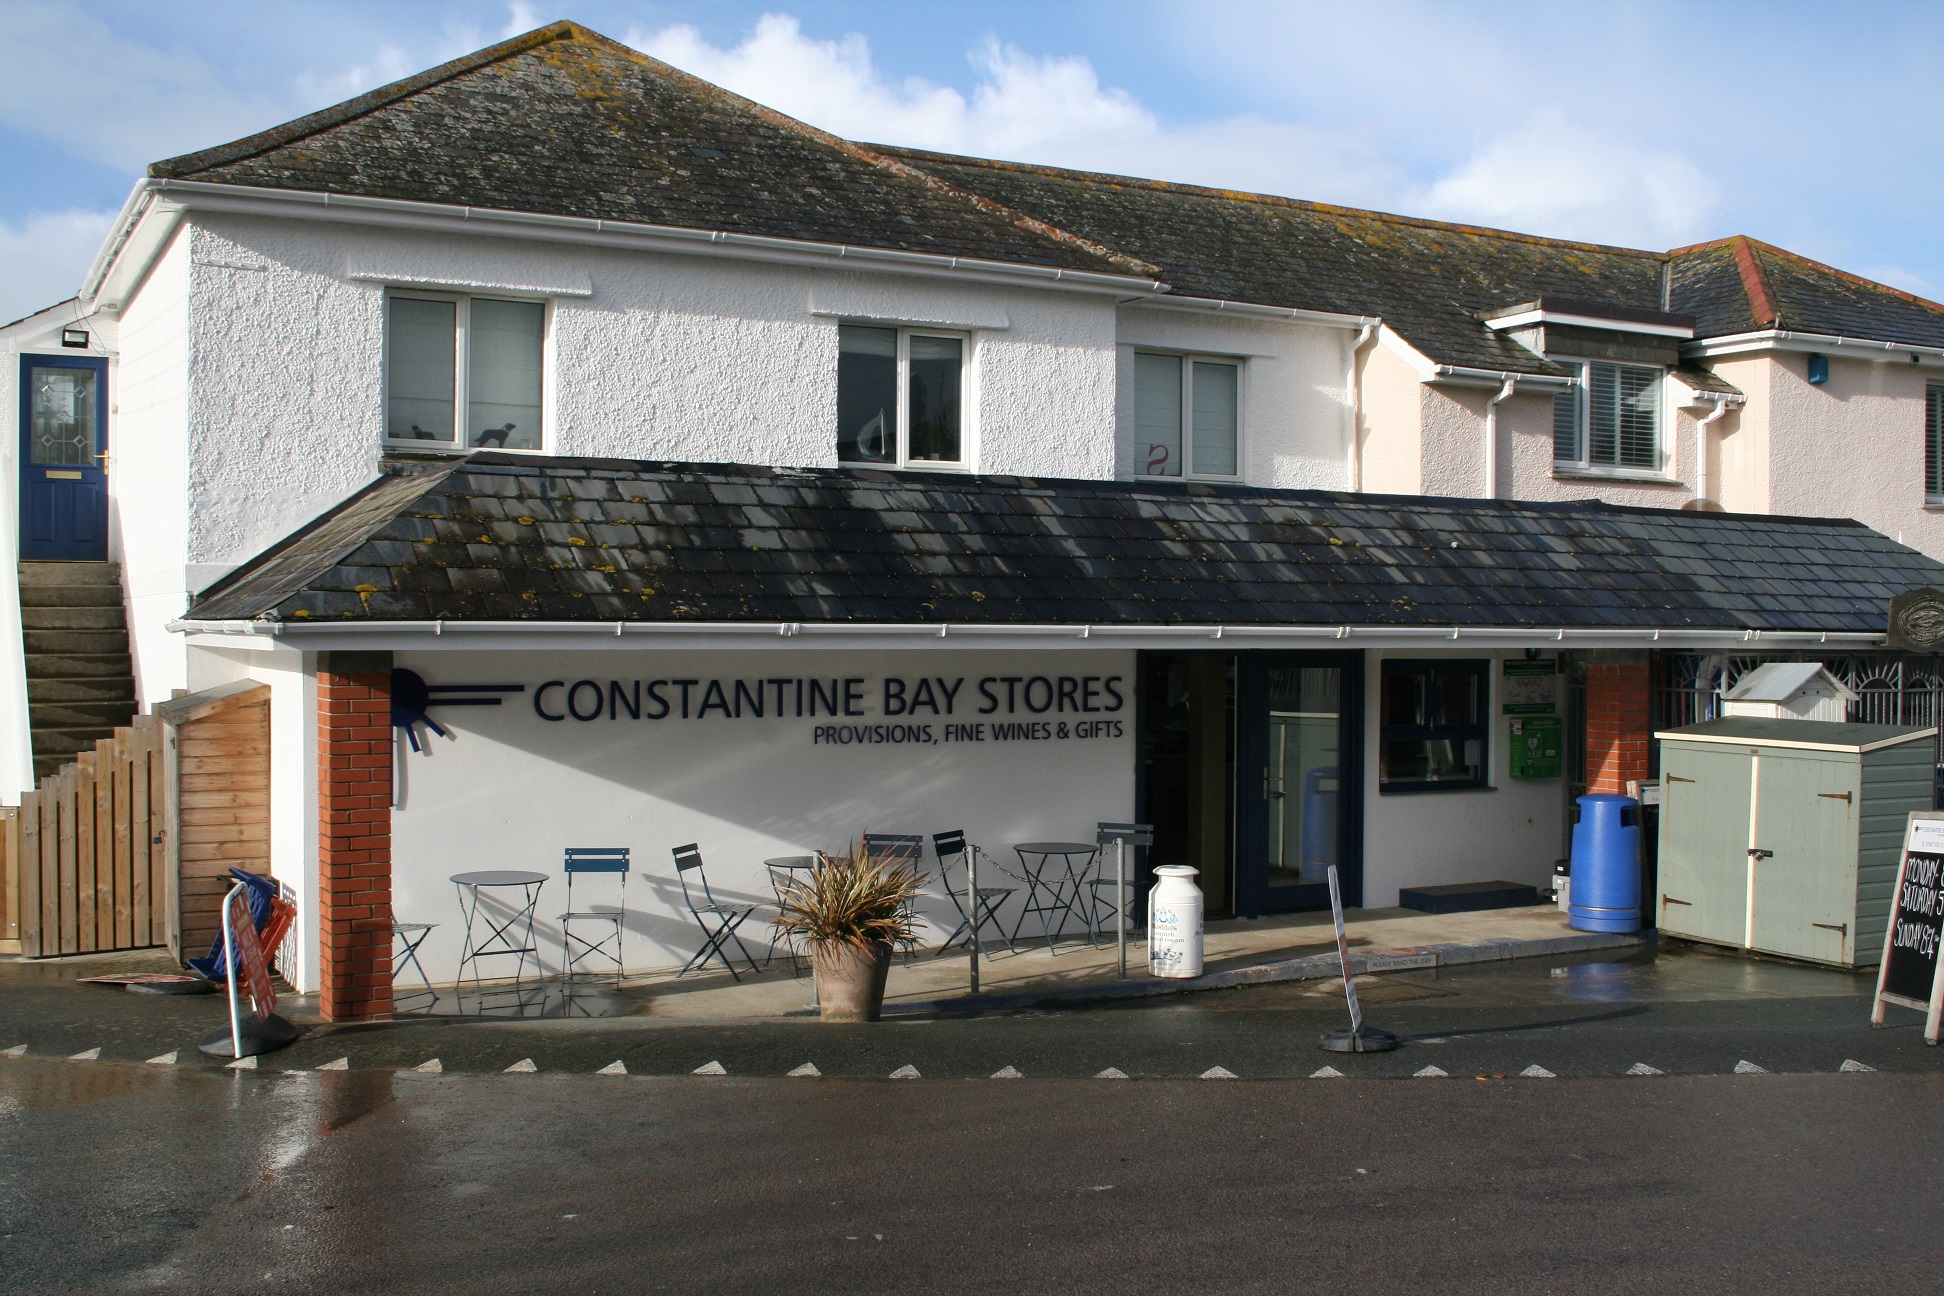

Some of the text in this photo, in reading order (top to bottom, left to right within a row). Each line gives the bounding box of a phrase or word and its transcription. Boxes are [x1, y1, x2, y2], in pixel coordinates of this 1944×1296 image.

[534, 675, 1124, 722] CONSTANTINE BAY STORES
[813, 720, 1124, 745] PROVISIONS, FINE WINES & GIFTS
[1900, 882, 1938, 917] SATURDAY
[1894, 917, 1924, 951] SUNDAY
